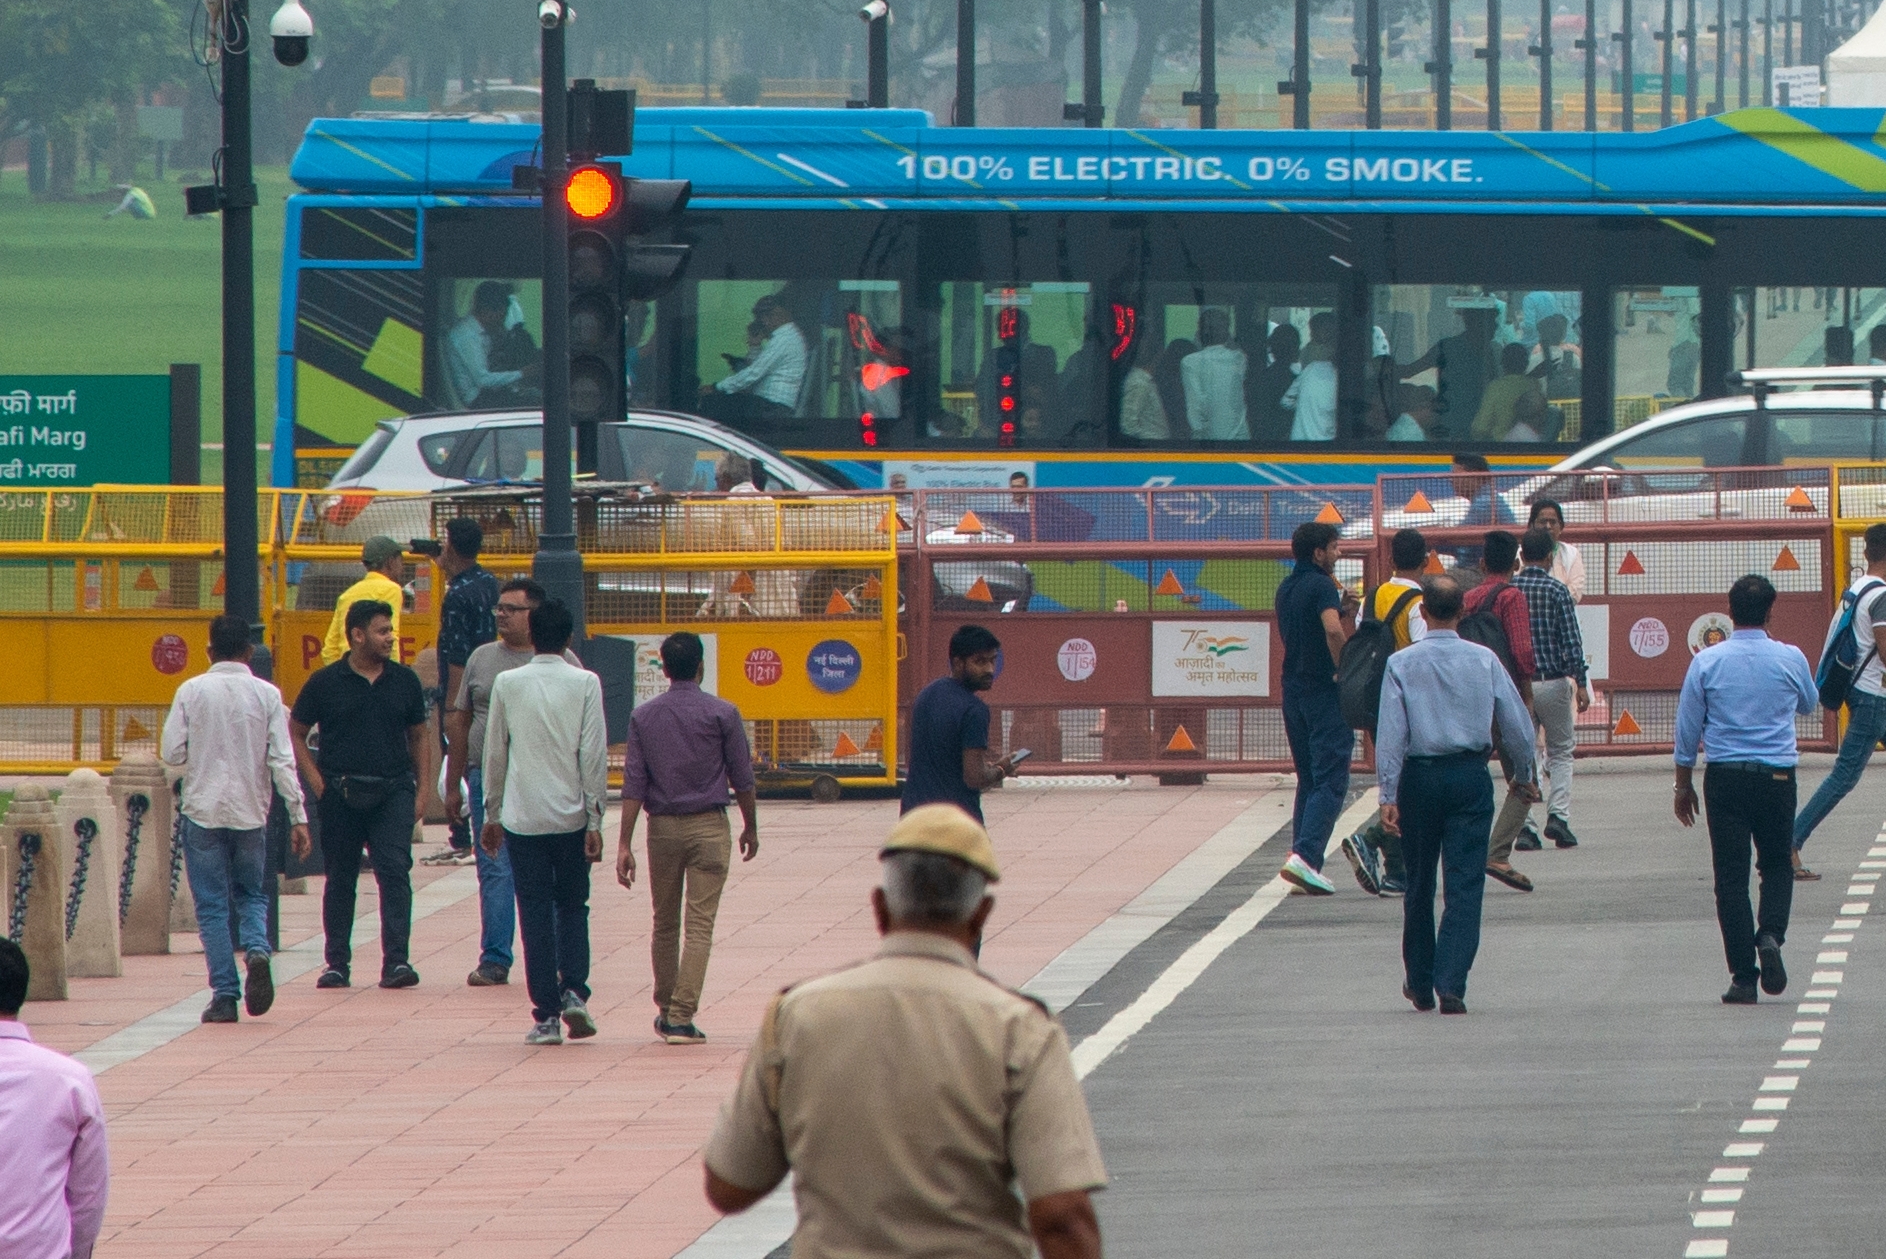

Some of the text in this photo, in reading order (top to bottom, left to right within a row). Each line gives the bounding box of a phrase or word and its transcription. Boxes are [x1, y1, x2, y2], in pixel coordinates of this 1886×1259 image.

[897, 156, 1484, 182] 100% ELECTRIC. 0% SMOKE.
[36, 390, 77, 414] मार्ग
[31, 427, 86, 450] Marg
[1186, 668, 1258, 686] अमृत महोत्सव
